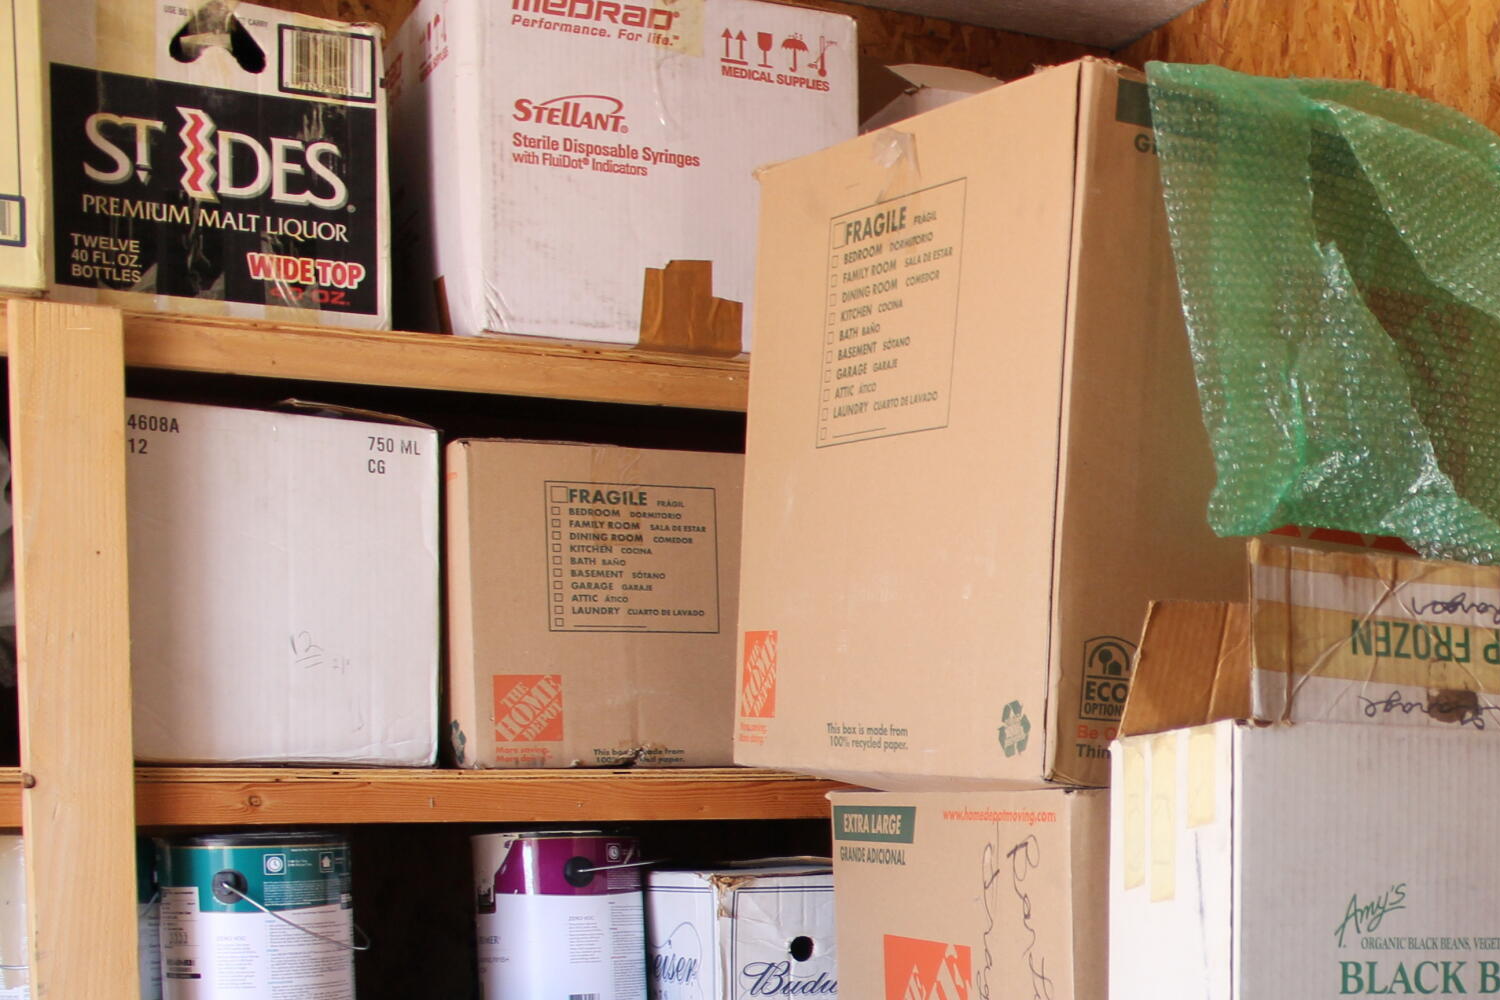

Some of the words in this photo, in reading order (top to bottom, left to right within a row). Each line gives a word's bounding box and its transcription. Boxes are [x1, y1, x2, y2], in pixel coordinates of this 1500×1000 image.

[512, 14, 611, 38] Performance.
[618, 29, 642, 41] For
[721, 65, 774, 83] MEDICAL
[777, 74, 829, 92] SUPPLIES
[513, 132, 559, 151] Sterile
[563, 138, 638, 159] Disposable
[642, 146, 700, 168] Syringes
[513, 151, 539, 165] with
[592, 158, 648, 176] Indicators
[82, 194, 191, 224] PREMIUM
[198, 205, 257, 233] MALT
[265, 215, 348, 243] LIQUOR
[845, 206, 907, 245] FRAGILE
[70, 232, 140, 253] TWELVE
[844, 244, 882, 264] BEDROOM
[890, 232, 933, 252] DORMITORIO
[72, 249, 88, 264] 40
[71, 264, 141, 284] BOTTLES
[247, 252, 313, 283] WIDE
[316, 261, 365, 290] TOP
[842, 286, 871, 303] DINING
[872, 279, 898, 294] ROOM
[906, 270, 940, 287] COMEDOR
[841, 304, 872, 322] KITCHEN
[878, 300, 903, 313] COCINA
[835, 386, 854, 400] ATTIC
[127, 414, 180, 434] 4608A
[127, 438, 148, 455] 12
[367, 436, 394, 453] 750
[400, 439, 421, 456] ML
[367, 458, 386, 474] CG
[568, 489, 648, 506] FRAGILE
[569, 508, 620, 517] BEDROOM
[630, 511, 682, 520] DORMITORIO
[569, 520, 604, 529] FAMILY
[608, 521, 640, 530] ROOM
[683, 525, 706, 533] ESTAR
[570, 533, 608, 542] DINING
[611, 533, 644, 542] ROOM
[653, 536, 693, 544] COMEDOR
[570, 545, 613, 553] KITCHEN
[570, 557, 596, 565] BATH
[601, 557, 626, 566] BAÑO
[571, 582, 614, 591] GARAGE
[571, 594, 598, 602] ATTIC
[572, 607, 620, 615] LAUNDRY
[673, 609, 705, 617] LAVADO
[1351, 618, 1470, 663] FROZEN
[501, 681, 530, 708] THE
[1085, 681, 1129, 702] ECO
[494, 674, 562, 742] HOME
[1084, 702, 1123, 715] OPTION
[521, 701, 563, 741] DEPOT
[1077, 725, 1098, 739] Be
[843, 813, 870, 834] EXTRA
[872, 814, 901, 835] LARGE
[943, 807, 1056, 825] www.homedepotmoving.com
[840, 846, 865, 862] GRANDE
[867, 848, 906, 865] ADICIONAL
[1334, 883, 1407, 948] Amy's
[1361, 936, 1406, 950] ORGANIC
[1408, 936, 1439, 950] BLACK
[1440, 937, 1472, 950] BEANS,
[653, 953, 697, 983] eiser
[1338, 960, 1468, 995] BLACK
